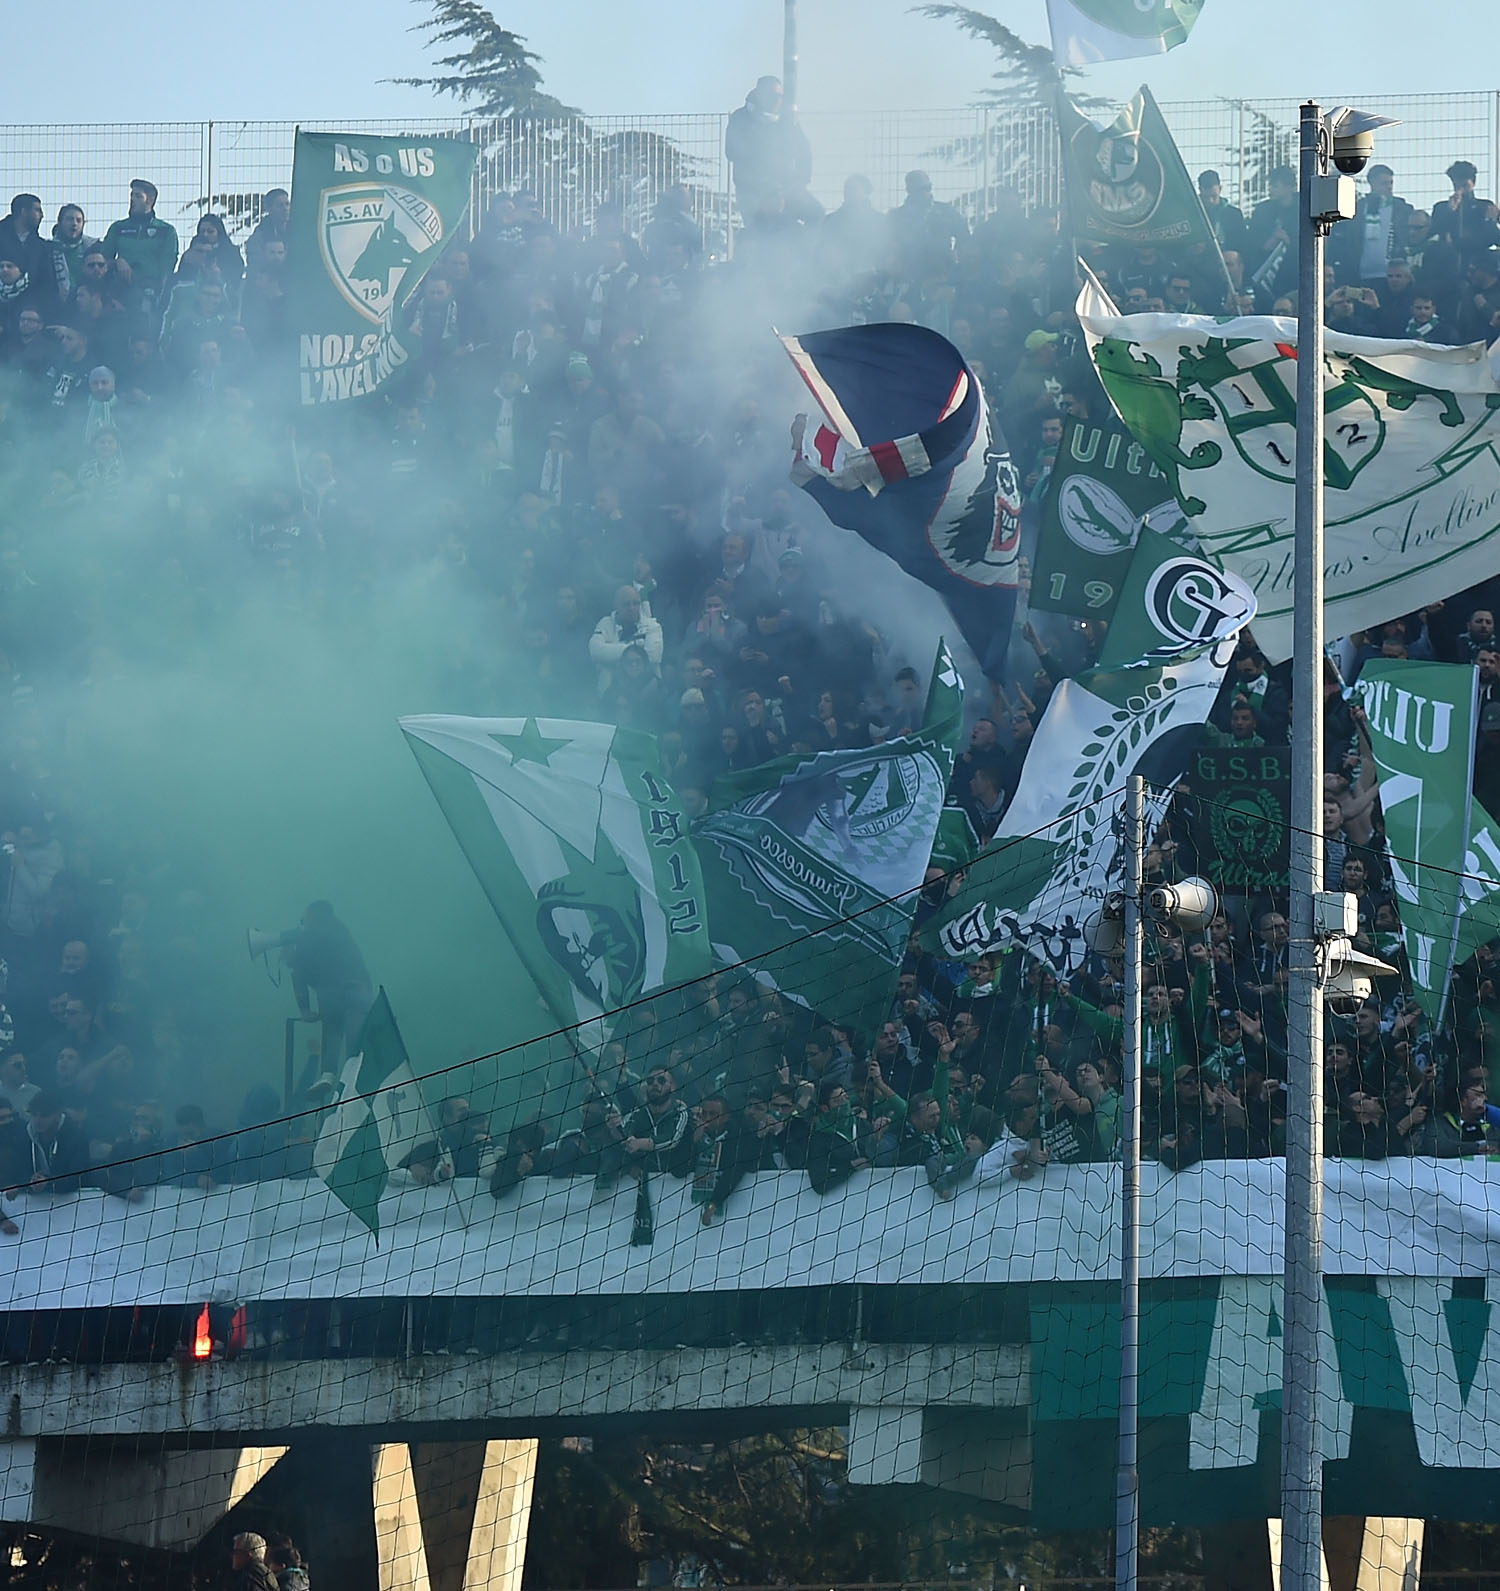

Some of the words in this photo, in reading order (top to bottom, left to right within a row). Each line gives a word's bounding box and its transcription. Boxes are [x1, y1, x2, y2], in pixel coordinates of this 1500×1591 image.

[334, 144, 370, 173] AS
[399, 148, 435, 177] US
[327, 206, 357, 221] A.S.
[363, 288, 380, 300] 19
[1197, 756, 1291, 781] G.S.B.
